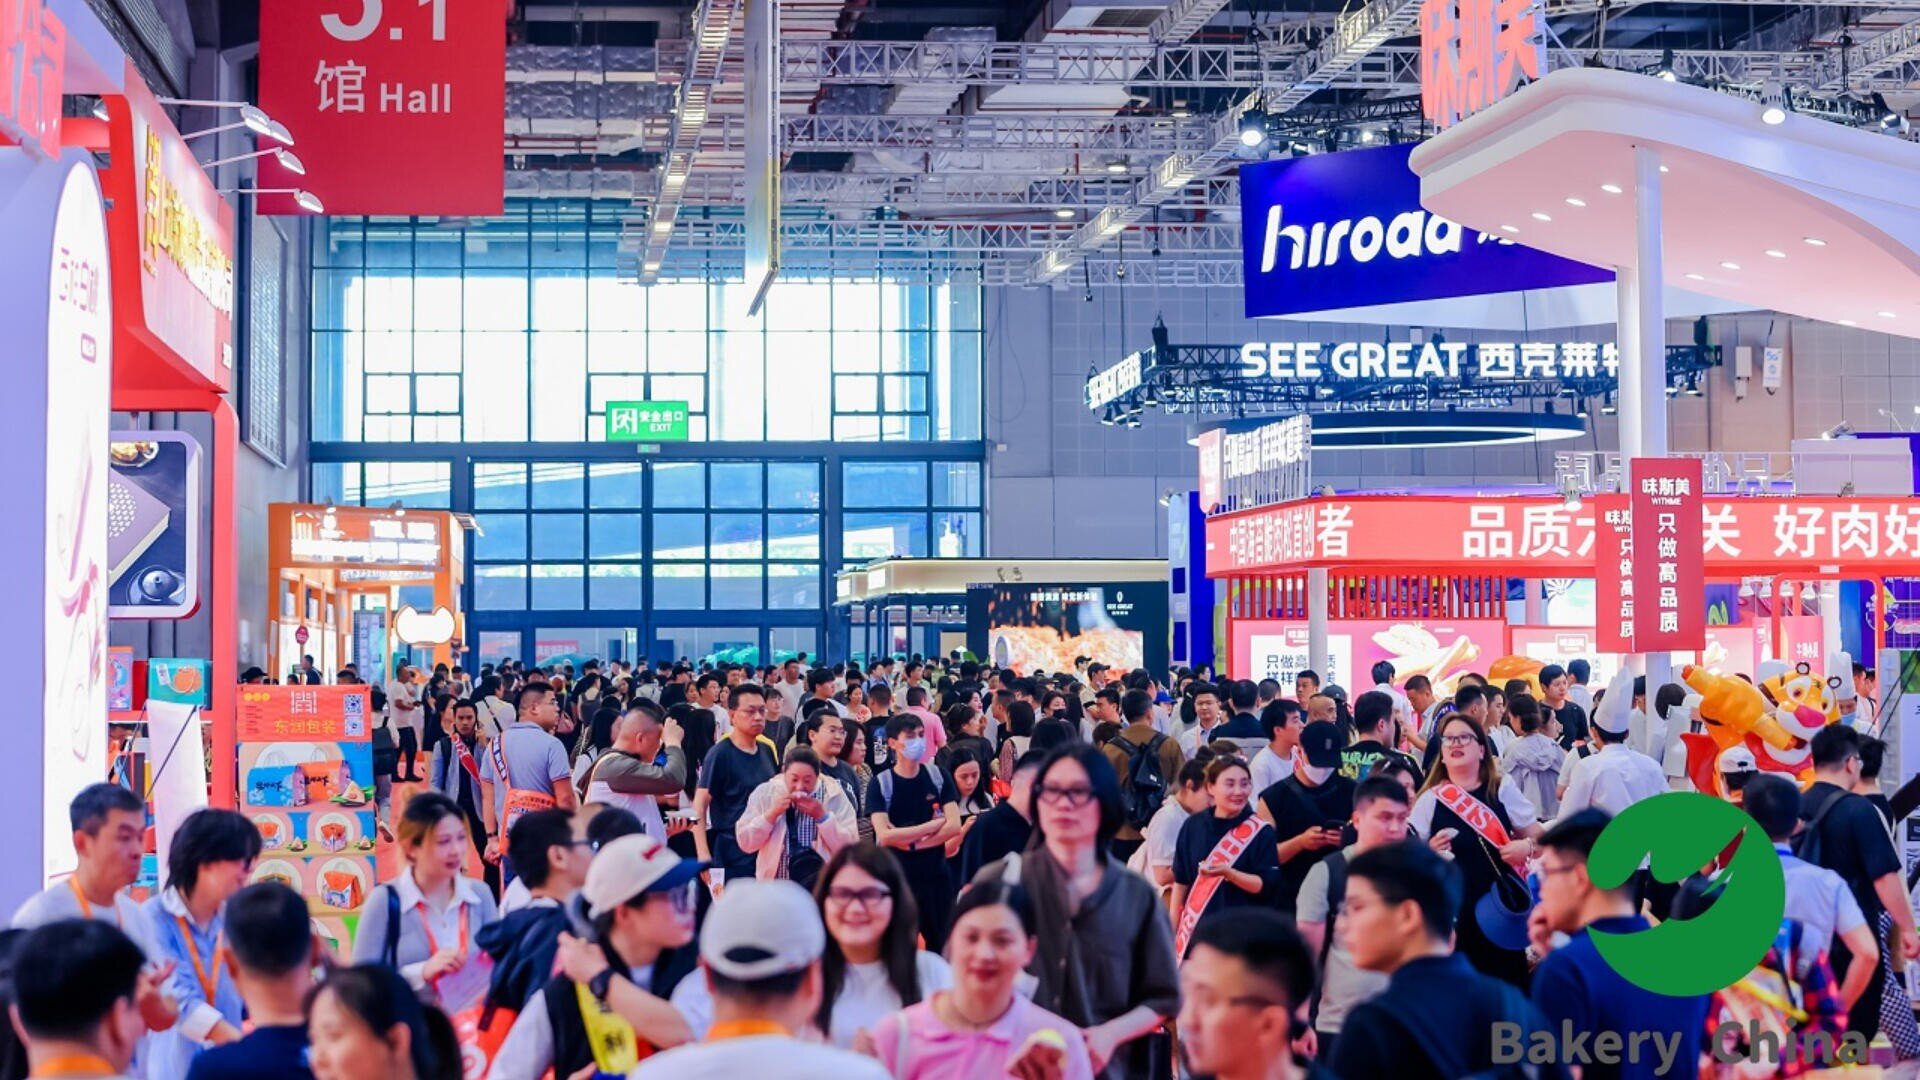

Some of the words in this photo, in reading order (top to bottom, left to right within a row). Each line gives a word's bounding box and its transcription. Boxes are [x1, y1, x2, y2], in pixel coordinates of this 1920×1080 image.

[313, 60, 367, 113] 馆
[380, 83, 451, 113] Hall
[1241, 342, 1321, 378] SEE
[1331, 342, 1467, 378] GREAT
[639, 410, 683, 422] 安全出口
[650, 423, 672, 433] EXIT
[1642, 477, 1690, 496] 味斯美
[1605, 510, 1632, 524] 味斯
[1773, 504, 1920, 558] 好肉好
[1657, 512, 1679, 633] 只做高品质
